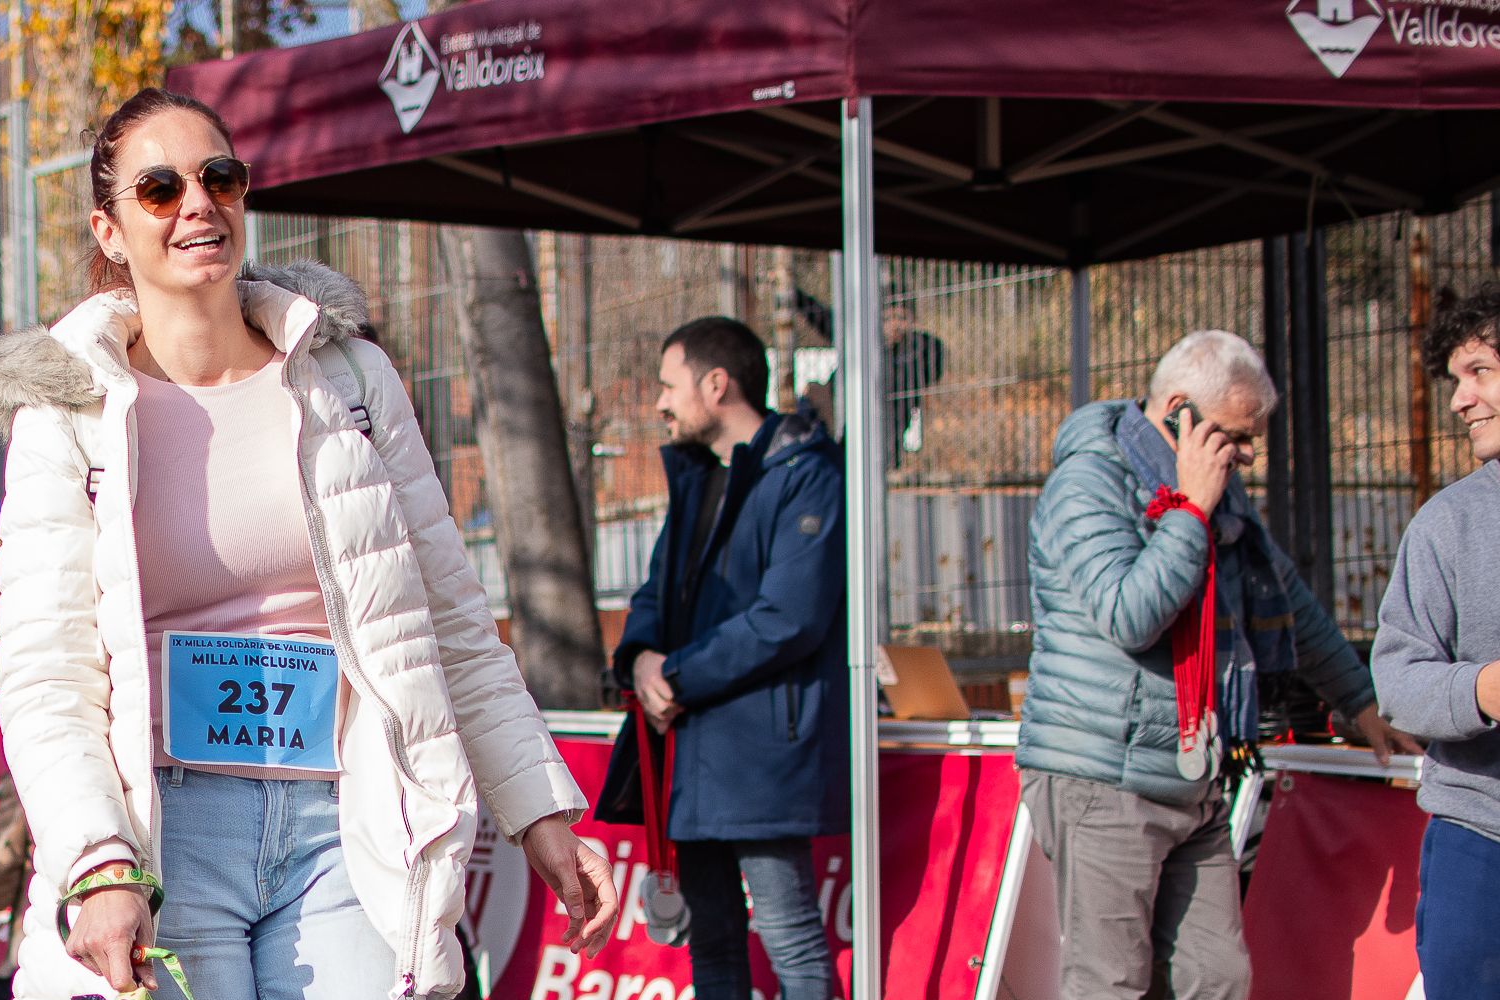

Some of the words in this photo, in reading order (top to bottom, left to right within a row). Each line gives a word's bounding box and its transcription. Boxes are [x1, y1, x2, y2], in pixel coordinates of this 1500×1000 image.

[1387, 6, 1500, 49] Valldore
[440, 46, 545, 92] Valldoreix
[172, 639, 181, 647] IX
[185, 639, 213, 648] MILLA
[268, 642, 281, 650] DE
[284, 645, 336, 657] VALLDOREIX
[191, 653, 239, 665] MILLA
[244, 654, 319, 673] INCLUSIVA
[217, 679, 296, 716] 237
[206, 724, 305, 750] MARIA
